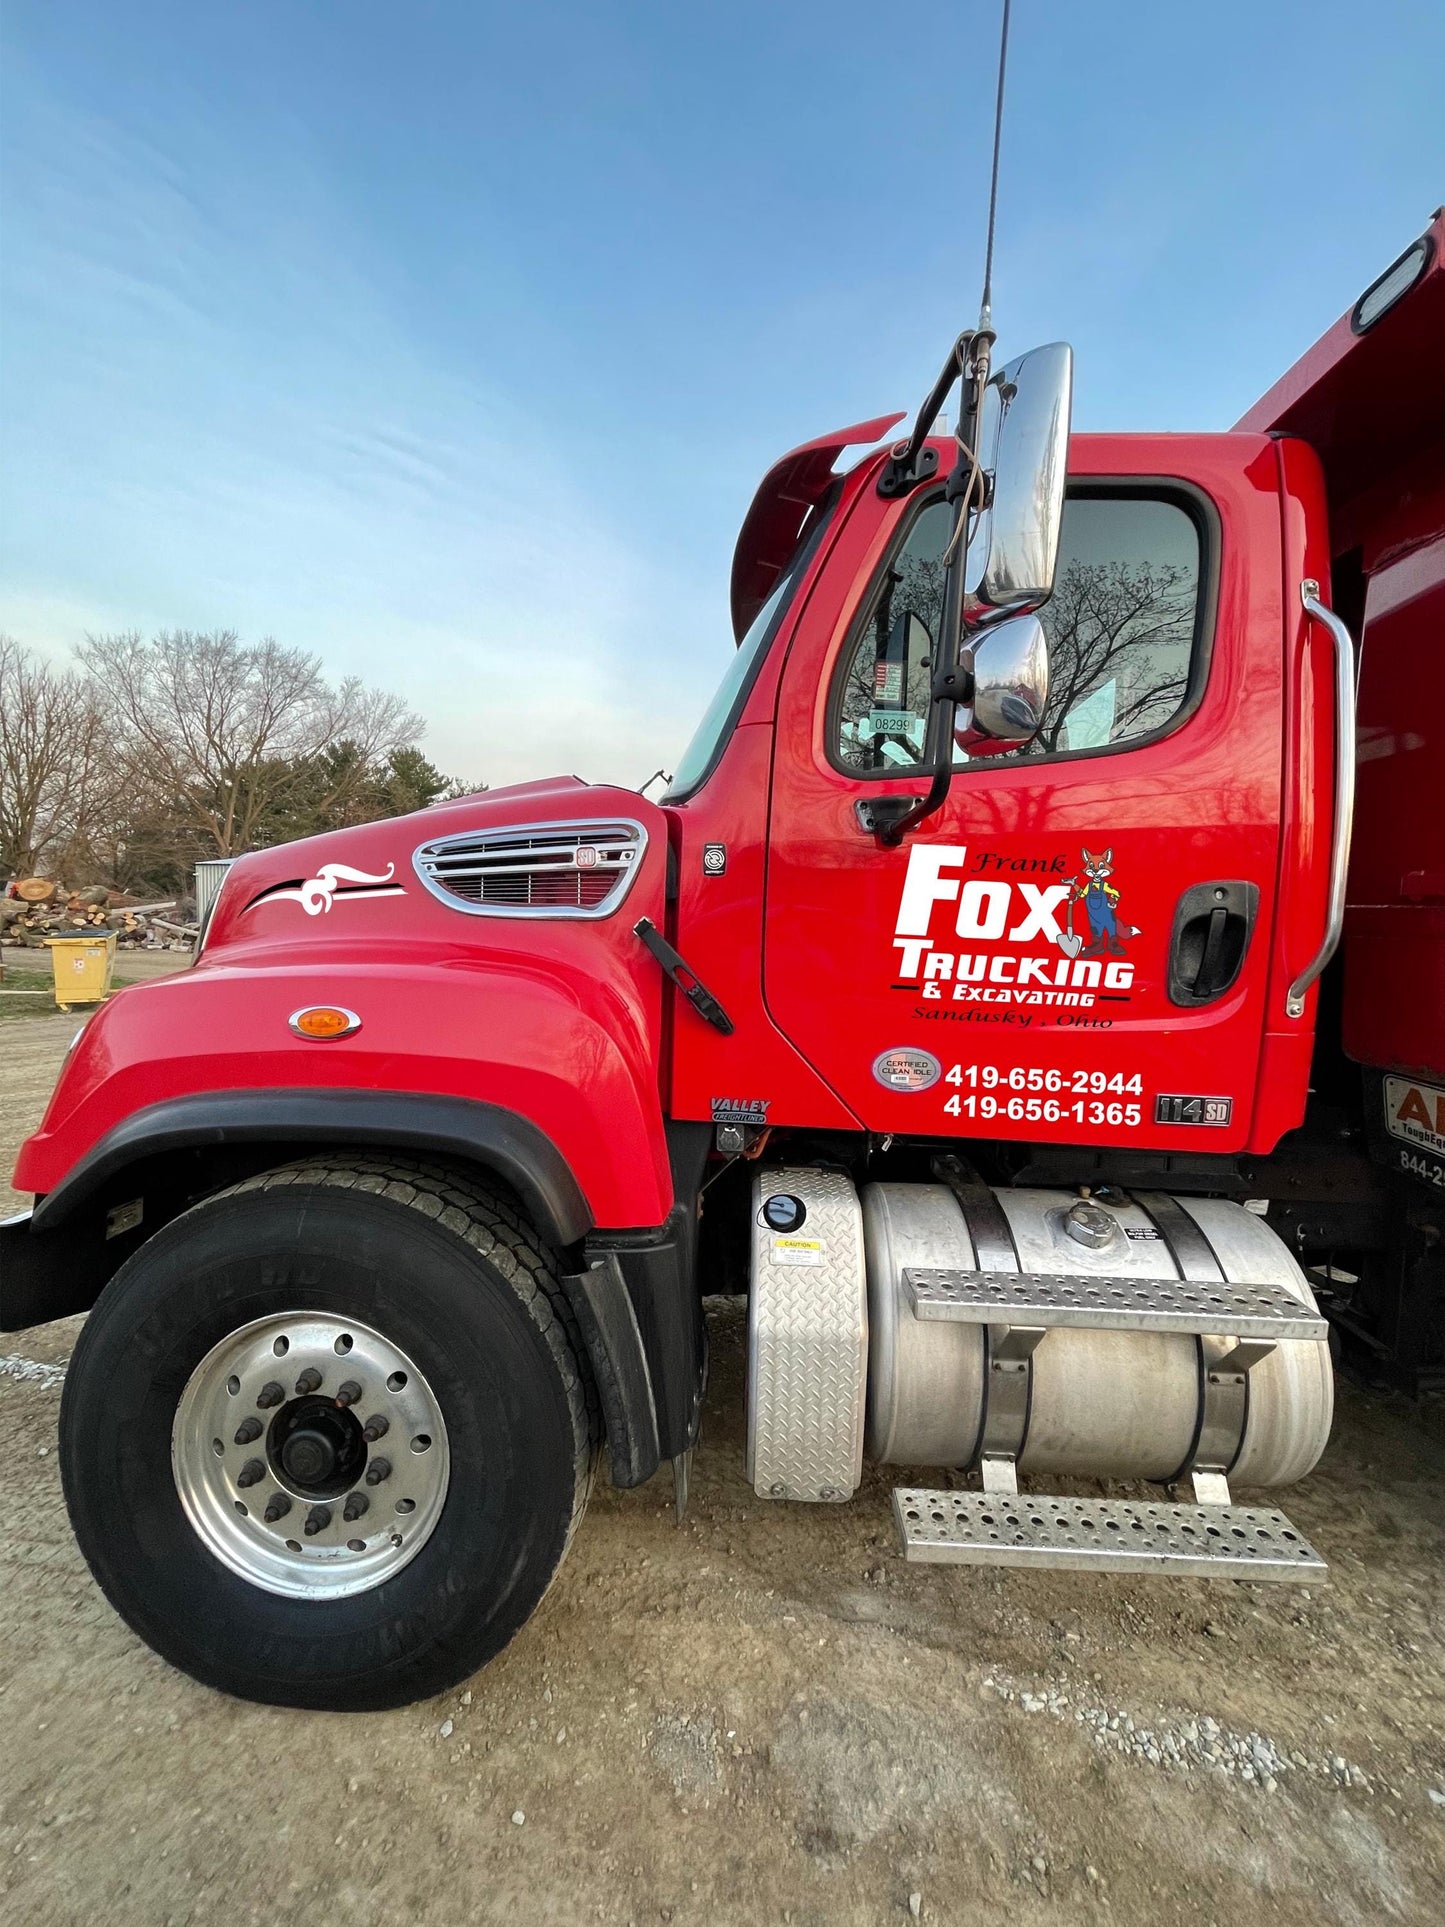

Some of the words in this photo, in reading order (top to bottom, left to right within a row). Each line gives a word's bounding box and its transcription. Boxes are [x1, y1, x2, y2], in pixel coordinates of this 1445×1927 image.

[875, 718, 910, 730] 08299
[971, 853, 1067, 873] Frank
[922, 981, 942, 999] &
[912, 1006, 1033, 1028] Sandusky
[1056, 1013, 1113, 1029] Ohio
[881, 1067, 910, 1075] CLEAN
[886, 1060, 929, 1068] CERTIFIED
[945, 1064, 1143, 1096] 419-656-2944
[711, 1097, 771, 1113] VALLEY
[943, 1094, 1141, 1127] 419-656-1365
[1161, 1097, 1202, 1122] 114
[1205, 1103, 1227, 1121] SD
[715, 1113, 764, 1122] FREIGHTLINER
